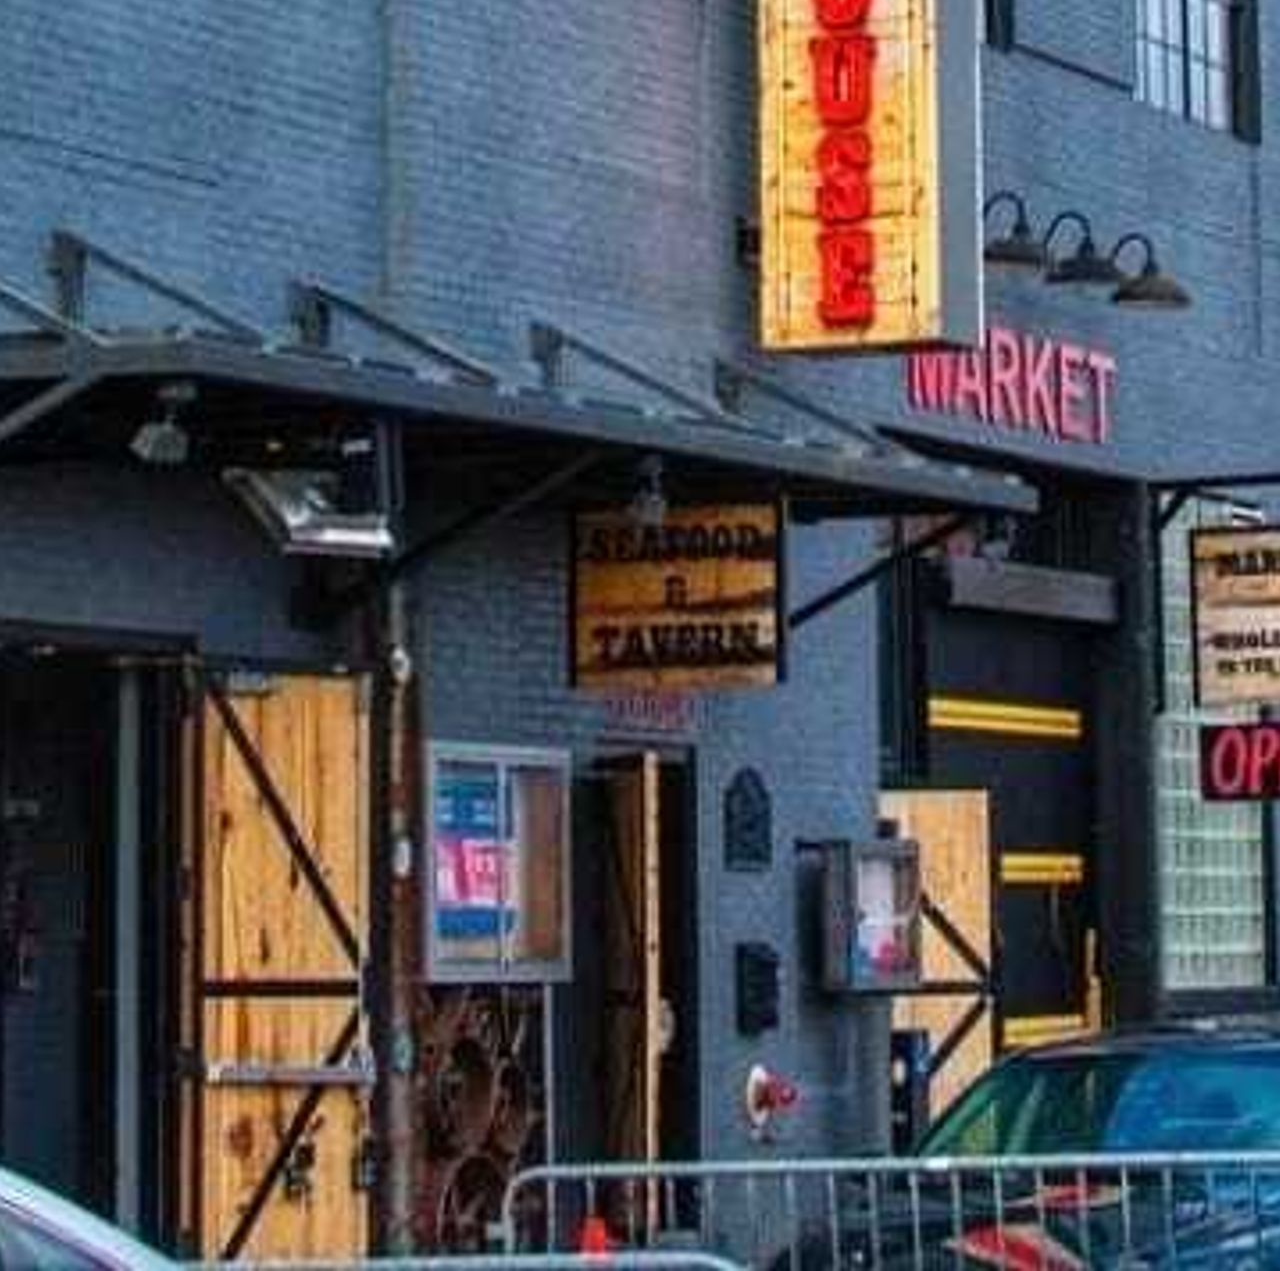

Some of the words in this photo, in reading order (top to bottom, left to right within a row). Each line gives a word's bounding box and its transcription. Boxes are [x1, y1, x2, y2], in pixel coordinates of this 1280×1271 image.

[903, 326, 1117, 444] MARKET
[586, 523, 762, 563] SEAFOOD
[591, 621, 767, 670] TAVERN
